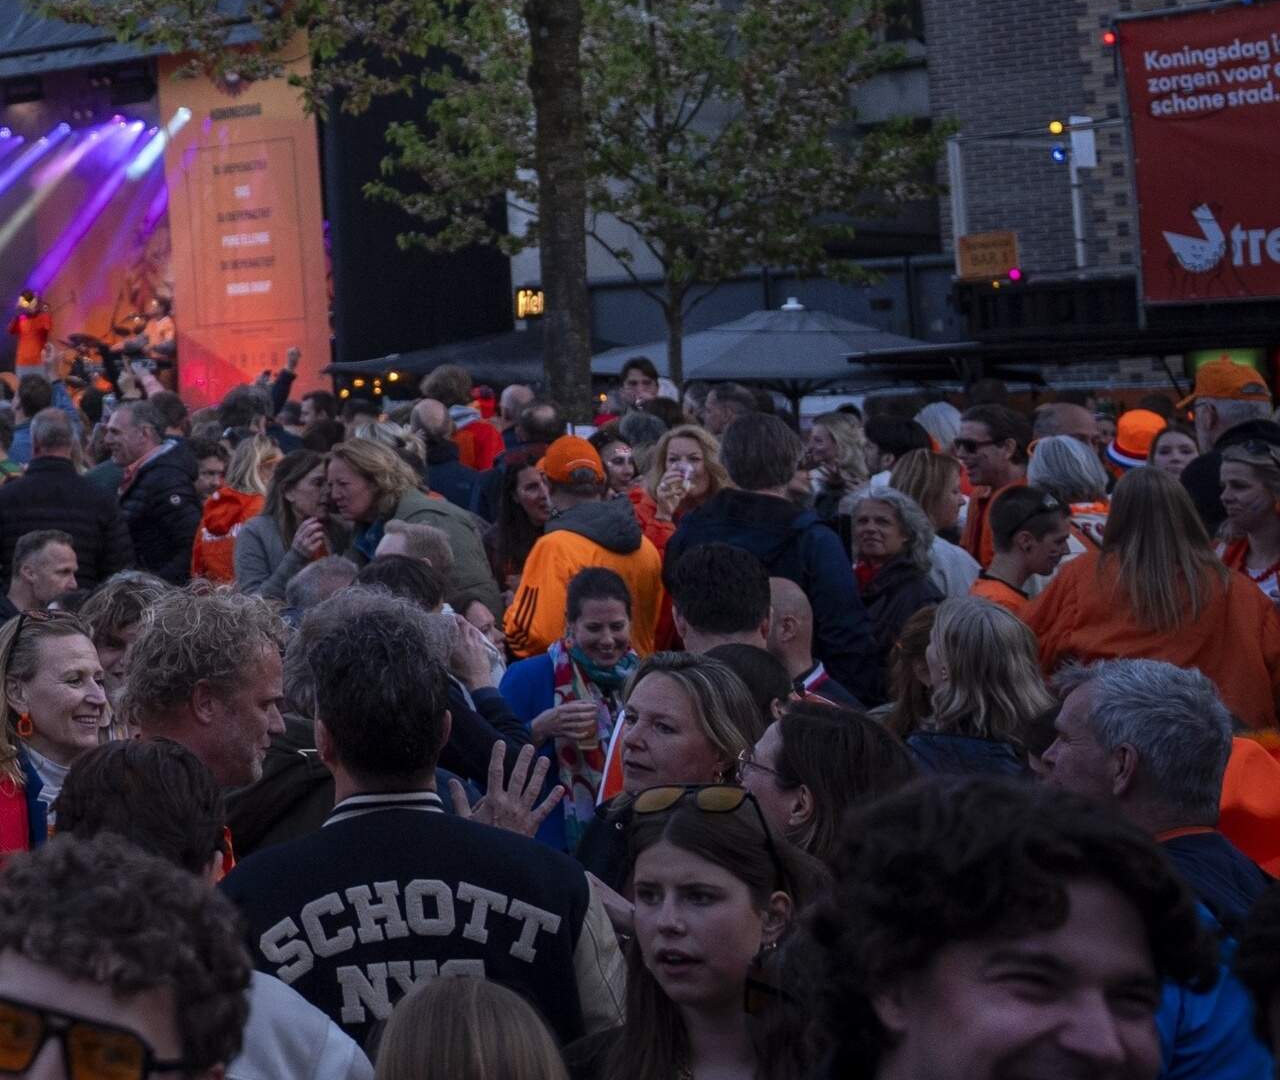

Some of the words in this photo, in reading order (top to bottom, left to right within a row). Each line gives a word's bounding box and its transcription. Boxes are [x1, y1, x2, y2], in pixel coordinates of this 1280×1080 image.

[1144, 38, 1271, 71] Koningsdag
[1271, 32, 1280, 54] i
[1148, 70, 1220, 94] zorgen
[1222, 63, 1271, 83] voor
[1151, 92, 1225, 116] schone
[259, 878, 562, 984] SCHOTT
[336, 958, 486, 1024] NY
